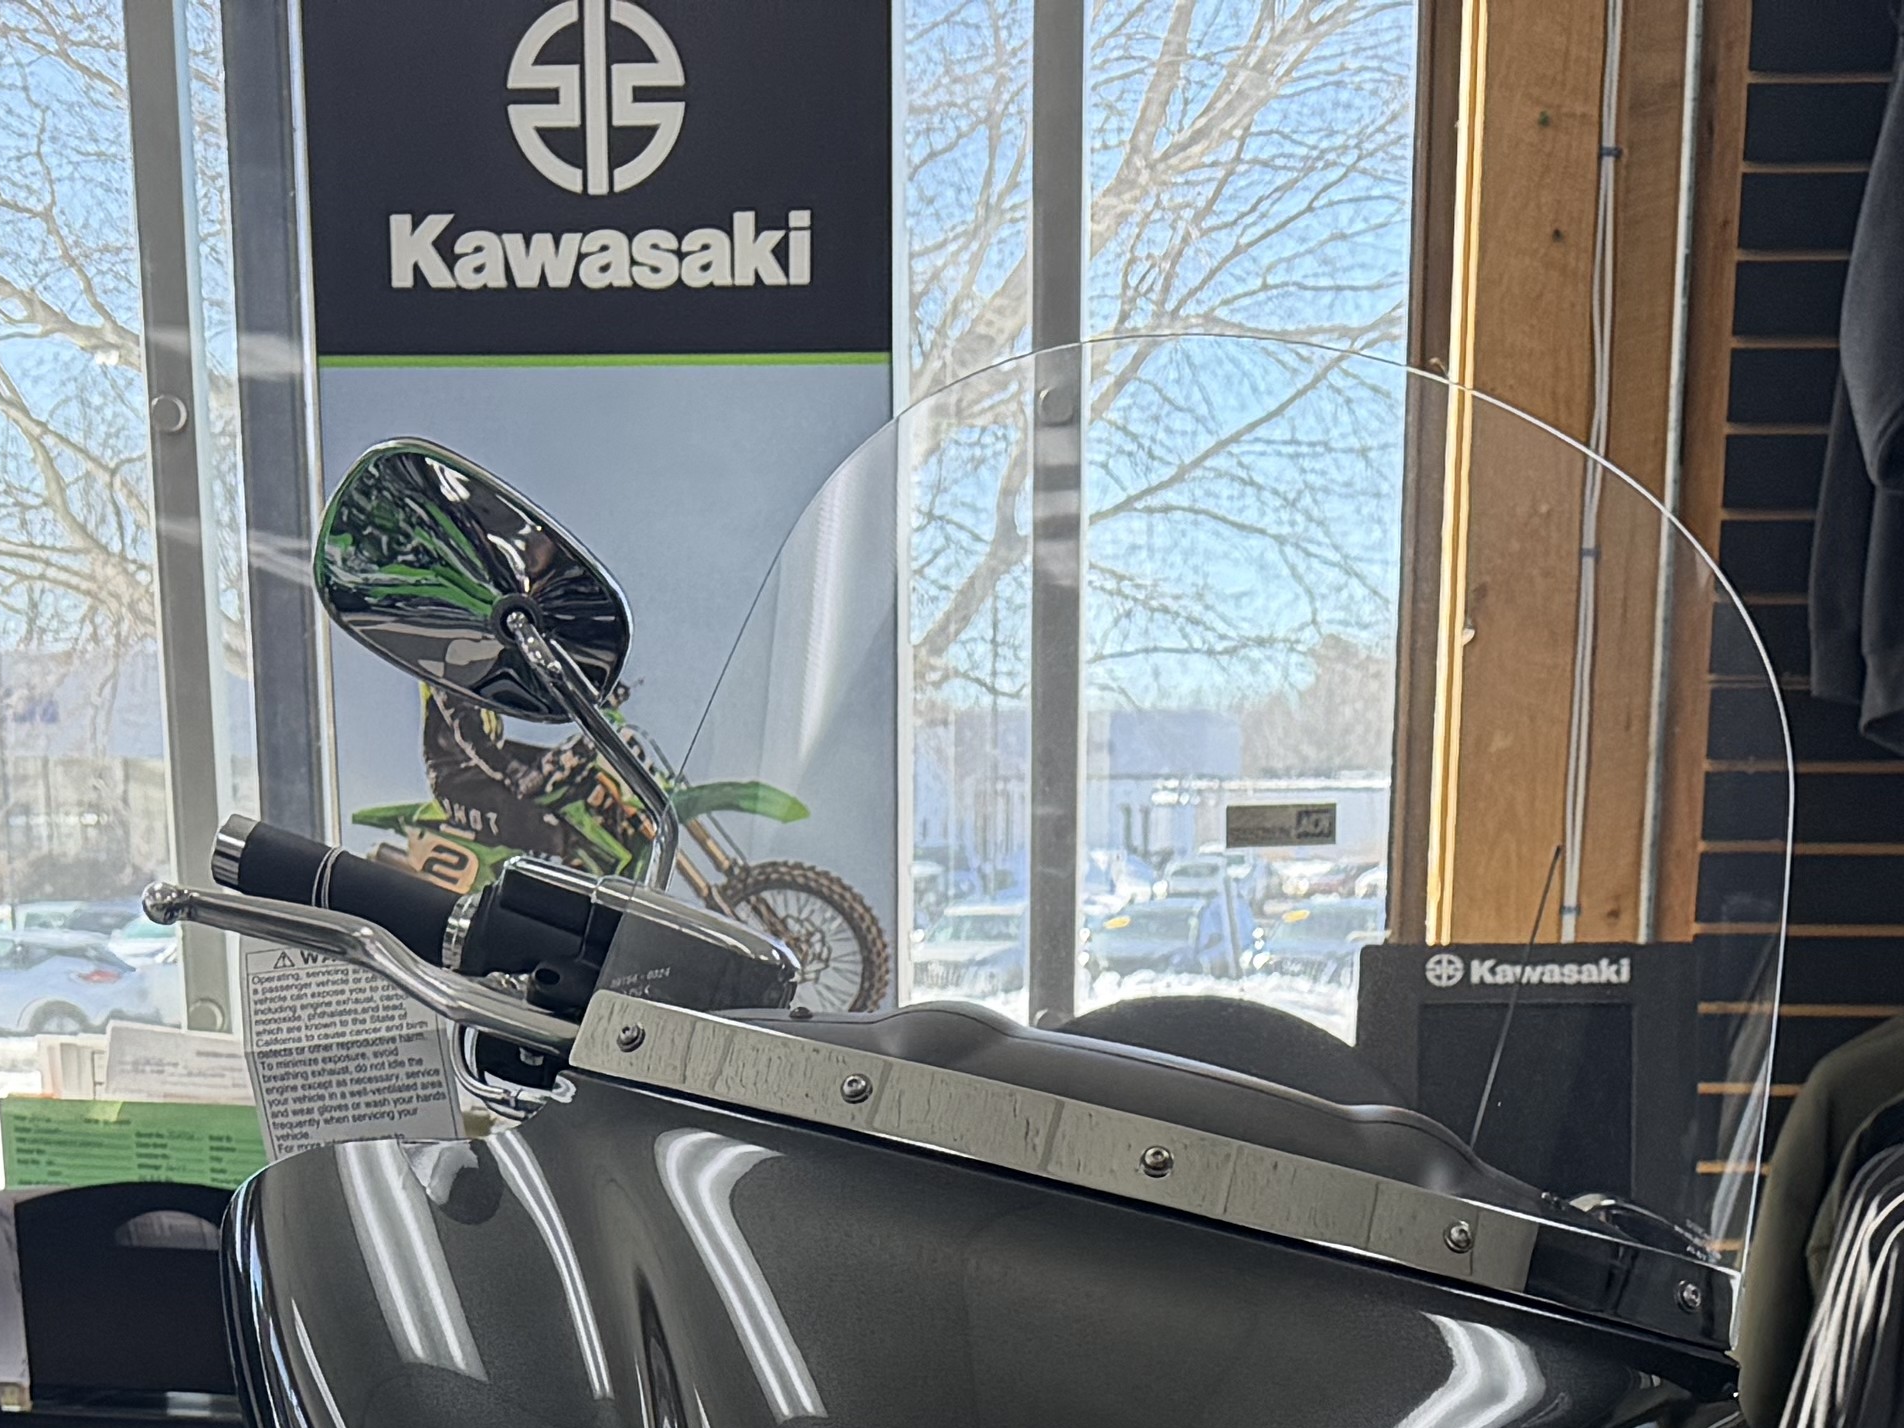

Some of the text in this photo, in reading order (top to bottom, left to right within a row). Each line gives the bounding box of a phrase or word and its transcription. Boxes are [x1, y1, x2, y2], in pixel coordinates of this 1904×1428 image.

[388, 209, 813, 291] Kawasaki
[1469, 957, 1631, 985] Kawasaki
[261, 982, 312, 996] passenger
[260, 1061, 274, 1072] To
[262, 1070, 309, 1083] breathing
[272, 1117, 321, 1131] frequently
[352, 1110, 395, 1122] servicing
